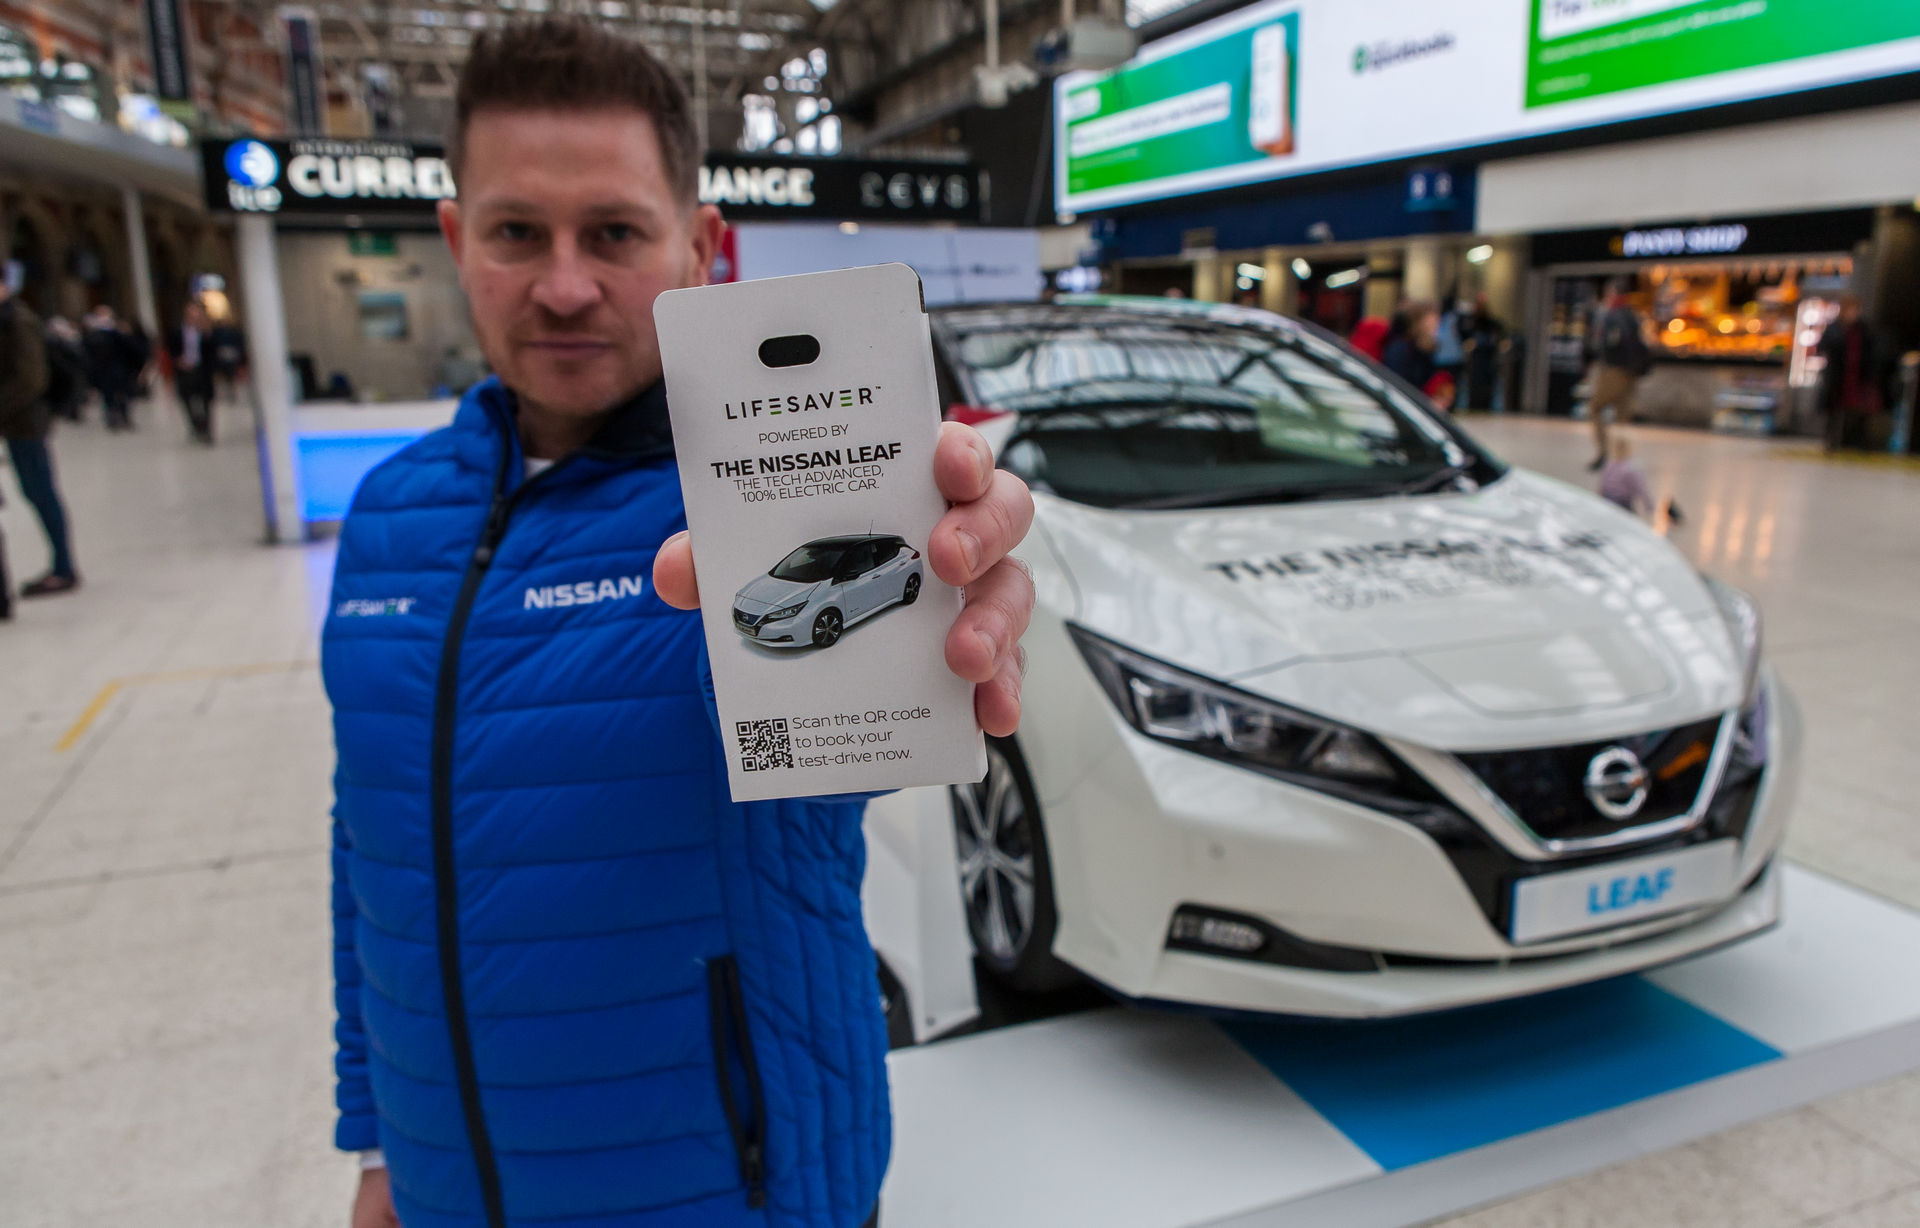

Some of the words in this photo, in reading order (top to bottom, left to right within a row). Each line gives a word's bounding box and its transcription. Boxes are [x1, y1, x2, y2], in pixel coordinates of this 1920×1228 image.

[758, 426, 828, 444] POWERED
[831, 424, 849, 437] BY
[710, 459, 755, 478] THE
[759, 449, 842, 474] NISSAN
[846, 442, 902, 465] LEAF
[733, 477, 761, 491] THE
[763, 473, 801, 488] TECH
[804, 464, 884, 484] ADVANCED,
[741, 489, 777, 503] 100%
[779, 481, 844, 500] ELECTRIC
[847, 478, 880, 492] CAR.
[1206, 552, 1318, 582] THE
[523, 575, 642, 610] NISSAN
[792, 717, 831, 730] Scan
[834, 713, 861, 726] the
[864, 710, 888, 724] QR
[891, 706, 931, 721] code
[795, 736, 812, 749] to
[815, 732, 855, 747] book
[857, 730, 893, 747] your
[798, 750, 872, 768] test-drive
[875, 749, 913, 762] now.
[1587, 867, 1676, 916] LEAF
